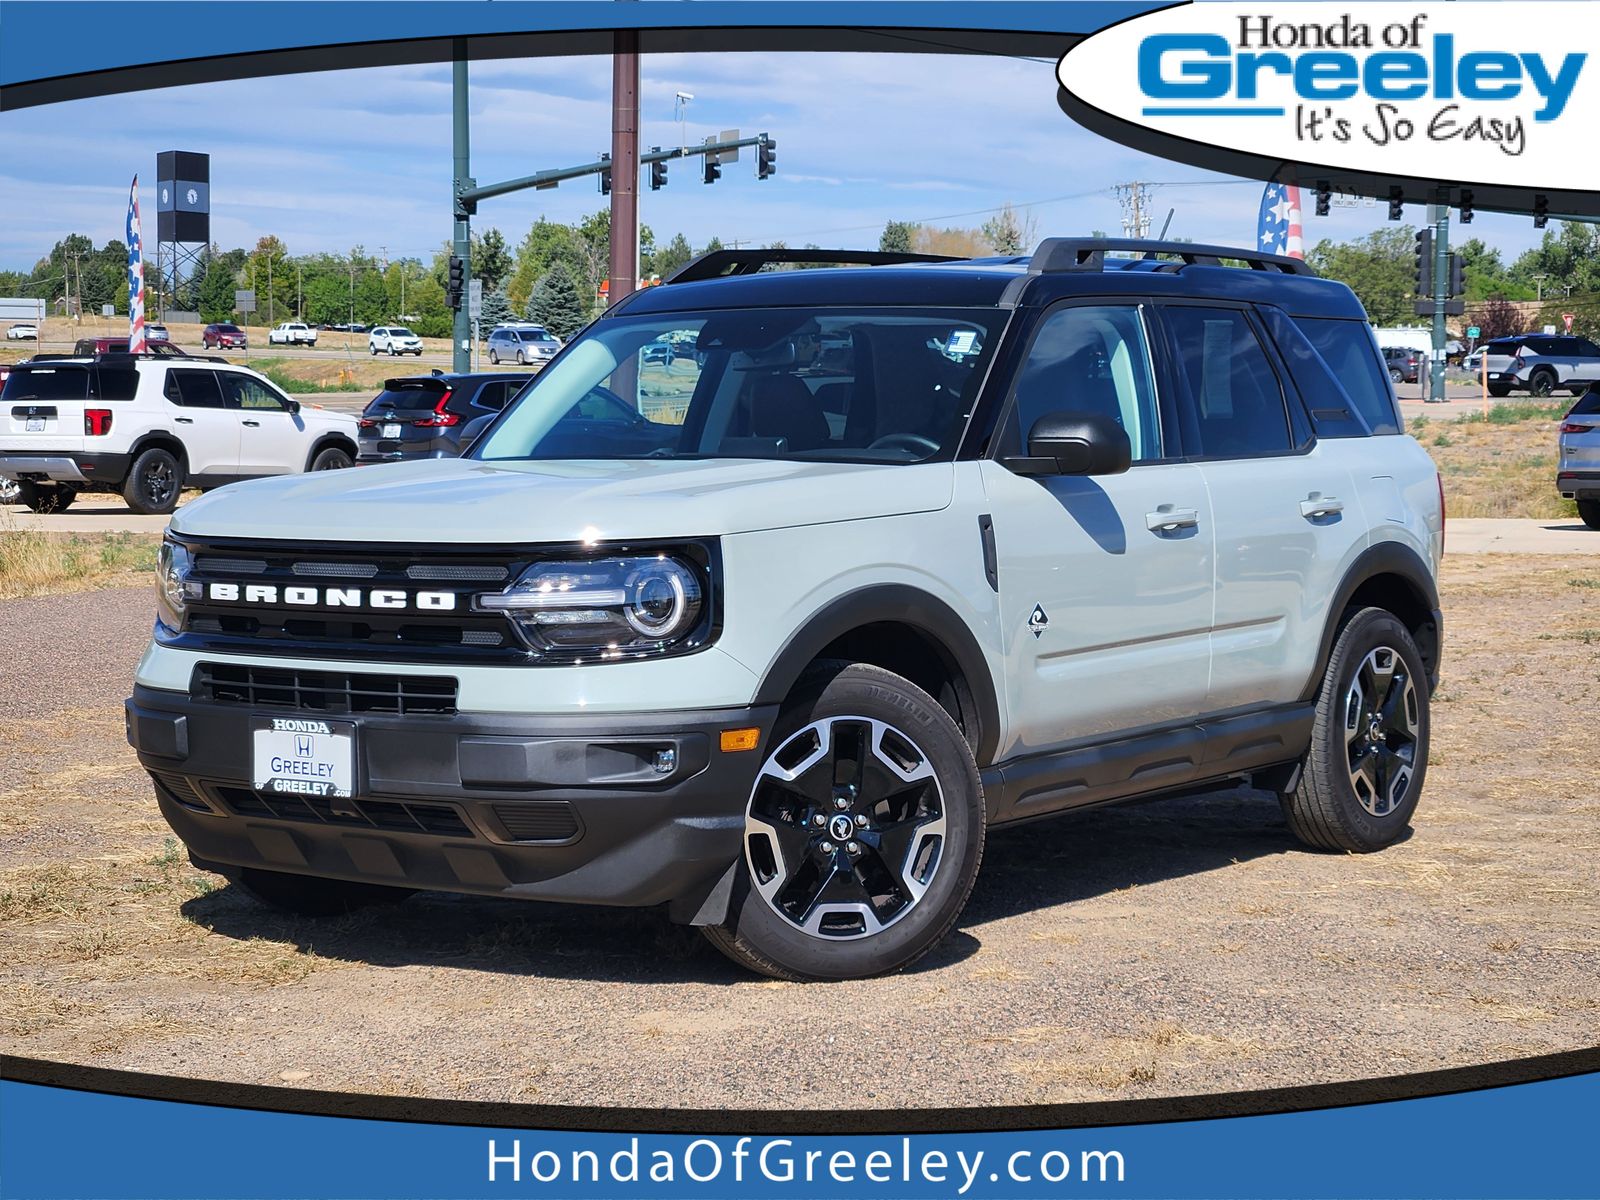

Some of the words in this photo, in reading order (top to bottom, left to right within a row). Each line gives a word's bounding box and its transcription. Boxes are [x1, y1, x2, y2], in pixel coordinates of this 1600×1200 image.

[209, 583, 456, 610] BRONCO
[272, 719, 331, 734] HONDA
[270, 756, 334, 778] GREELEY
[273, 779, 329, 796] GREELEY
